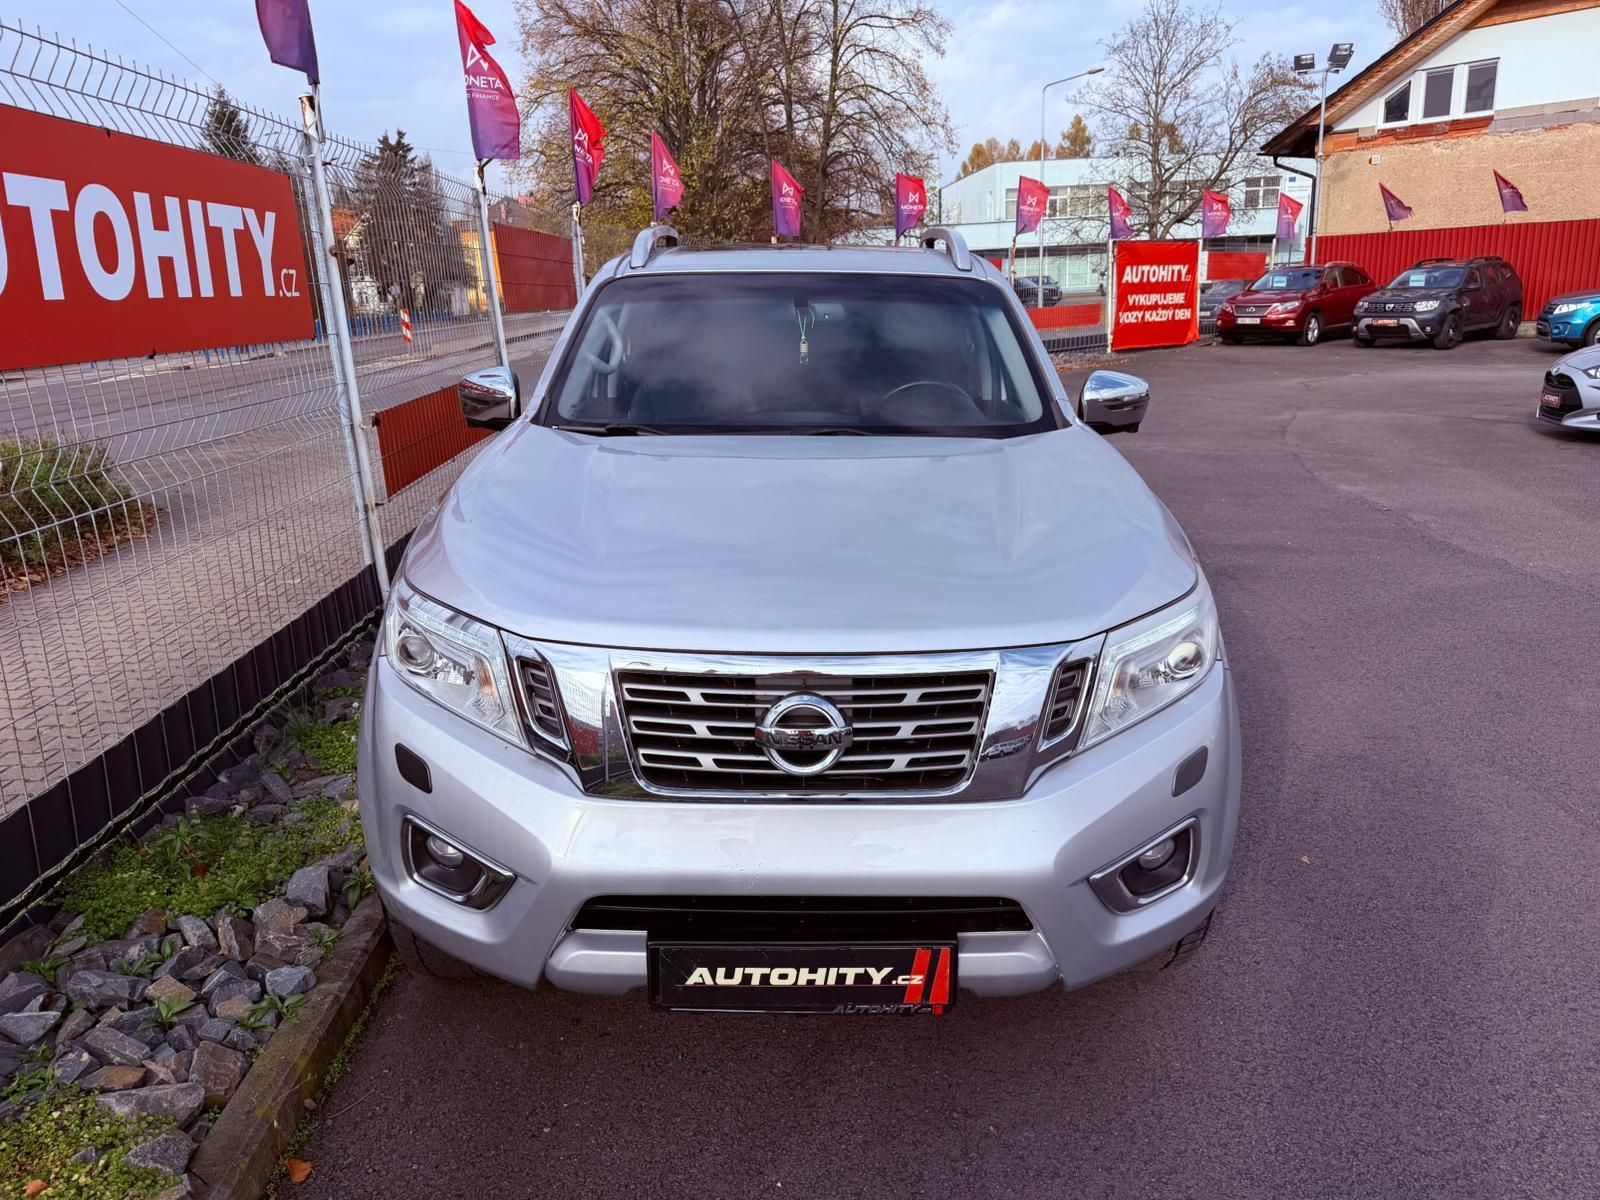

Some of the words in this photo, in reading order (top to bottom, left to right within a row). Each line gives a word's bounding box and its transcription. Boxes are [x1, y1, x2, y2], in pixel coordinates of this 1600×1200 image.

[0, 172, 300, 301] TOHITY.cz
[1128, 292, 1185, 305] VYKUPUJEME
[1119, 310, 1143, 323] VOZY
[1145, 307, 1173, 322] KAŽDÝ
[1175, 309, 1191, 320] DEN
[768, 731, 842, 746] NISSAN
[685, 967, 924, 986] AUTOHITY.cz
